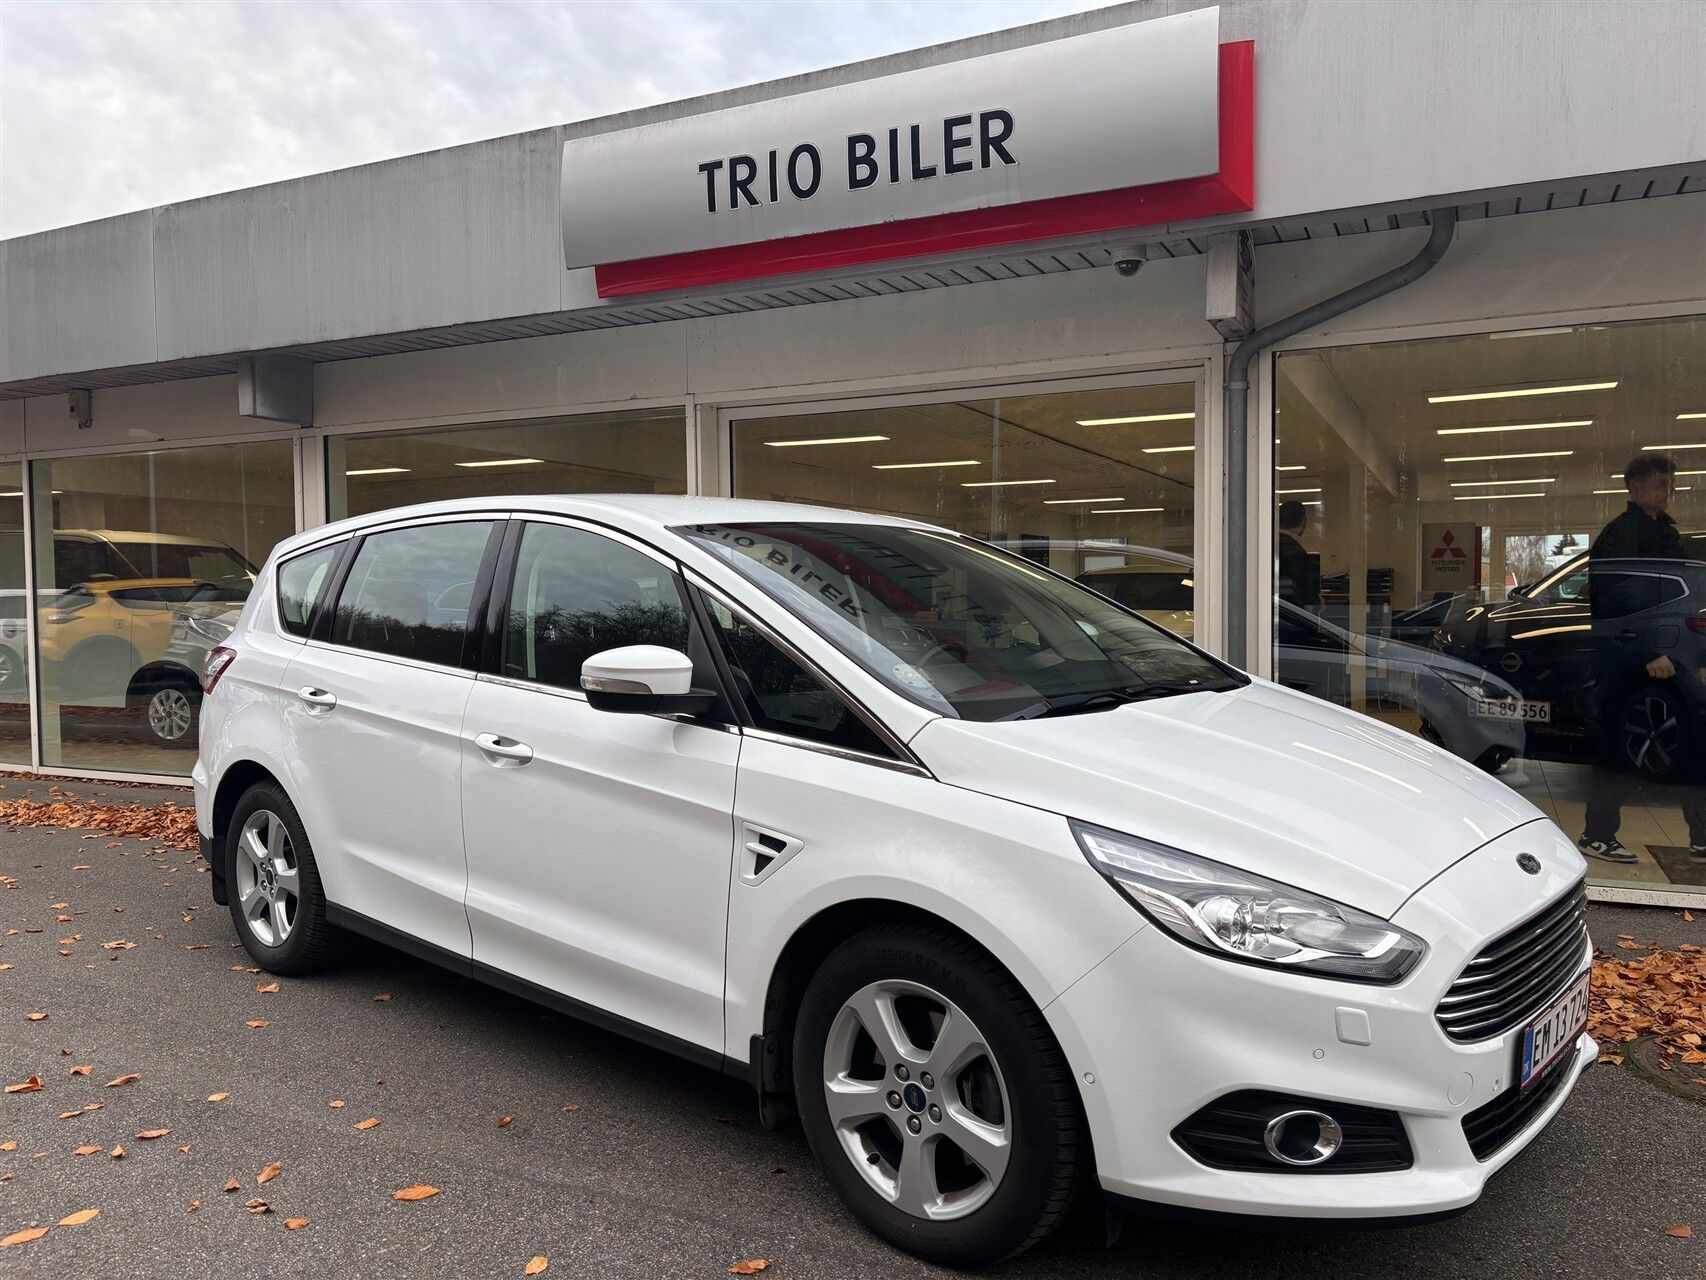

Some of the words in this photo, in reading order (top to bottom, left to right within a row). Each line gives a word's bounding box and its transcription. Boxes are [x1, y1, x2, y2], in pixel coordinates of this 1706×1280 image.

[699, 142, 822, 213] TRIO
[847, 107, 1019, 192] BILER
[1478, 702, 1495, 715] EE
[1499, 702, 1516, 717] 89
[1520, 703, 1548, 719] 556
[1533, 1019, 1551, 1067] EM
[1553, 1004, 1568, 1046] 13
